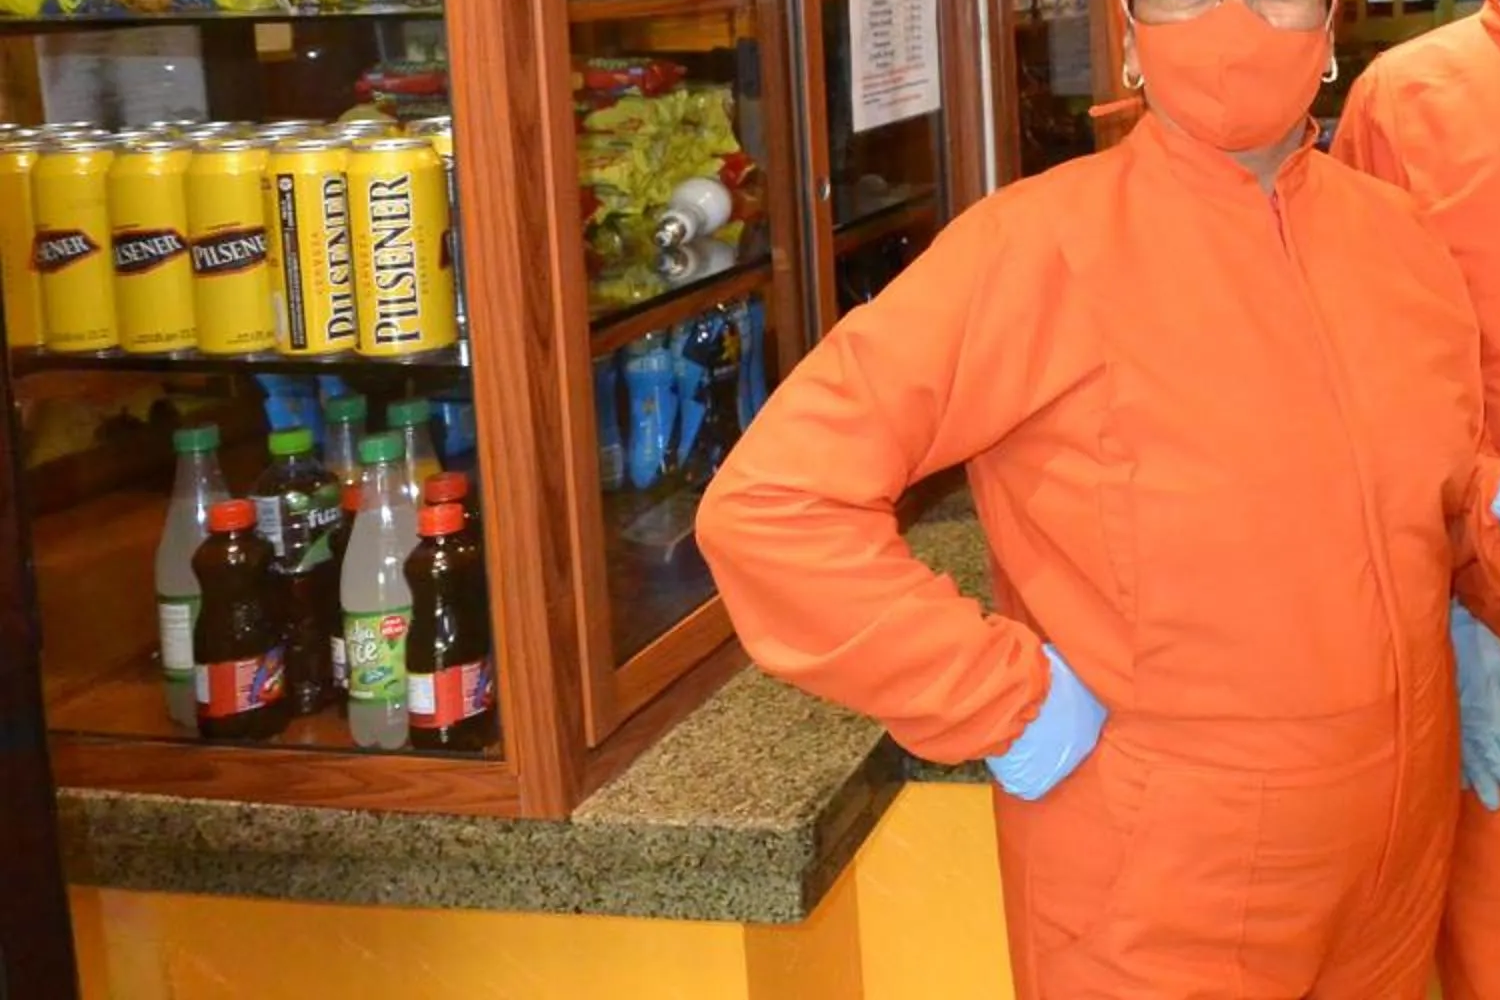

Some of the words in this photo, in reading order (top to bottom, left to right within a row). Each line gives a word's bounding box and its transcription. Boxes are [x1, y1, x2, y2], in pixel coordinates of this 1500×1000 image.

[39, 235, 91, 262] SENER
[115, 234, 183, 266] LSENER
[193, 235, 267, 270] PILSENE
[369, 175, 421, 344] PILSENER
